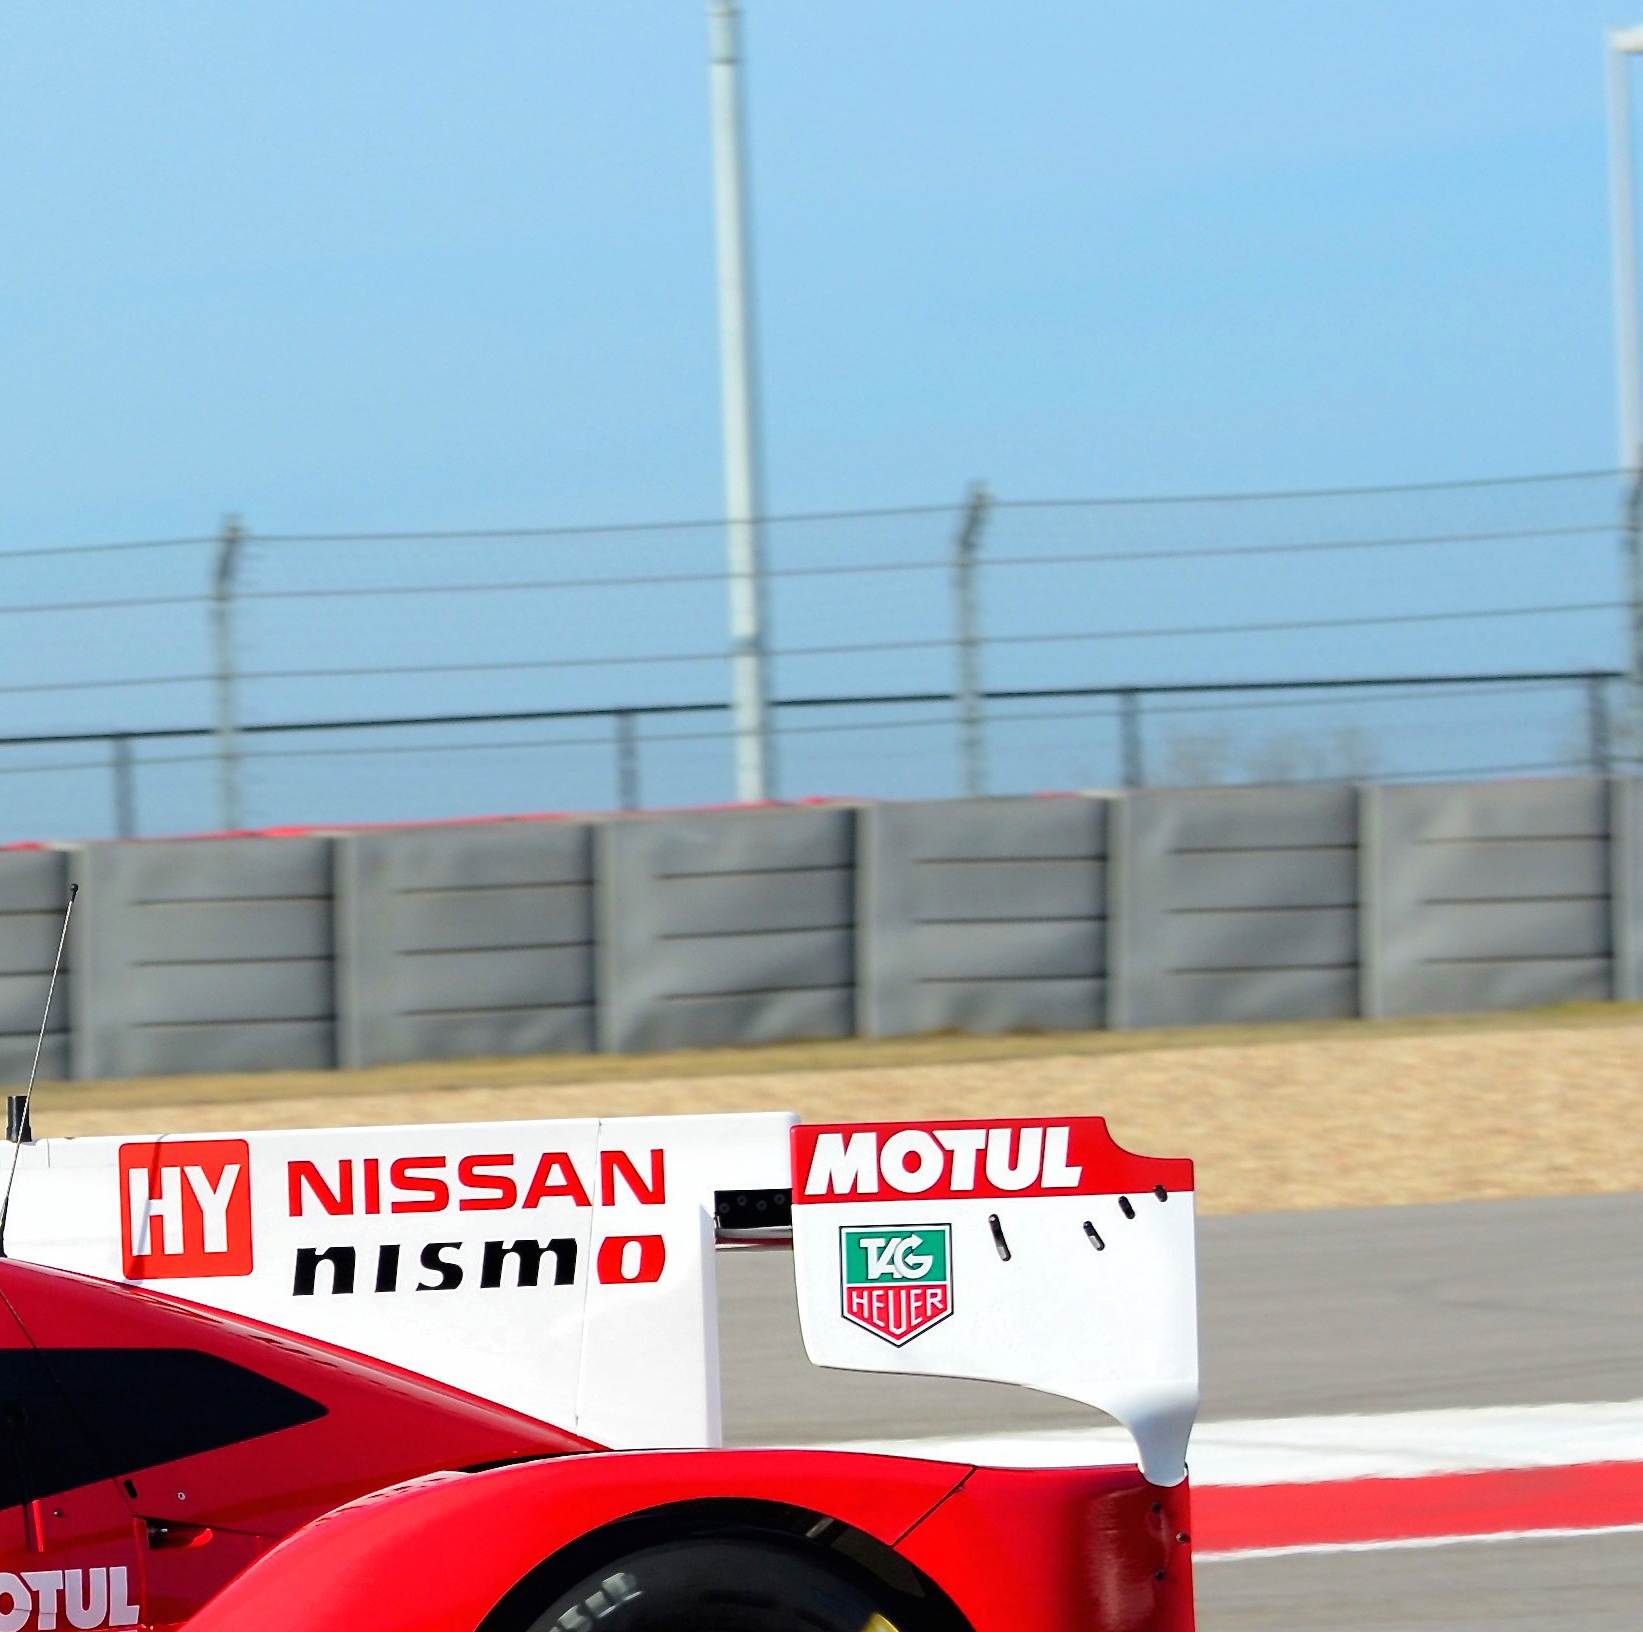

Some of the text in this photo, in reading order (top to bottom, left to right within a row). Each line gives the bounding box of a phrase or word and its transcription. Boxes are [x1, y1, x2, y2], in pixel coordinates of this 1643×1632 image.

[288, 1148, 666, 1217] NISSAN
[804, 1126, 1083, 1195] MOTUL
[128, 1163, 242, 1257] HY
[292, 1234, 666, 1297] nismo
[860, 1233, 935, 1281] TAG
[850, 1286, 944, 1335] HEUER
